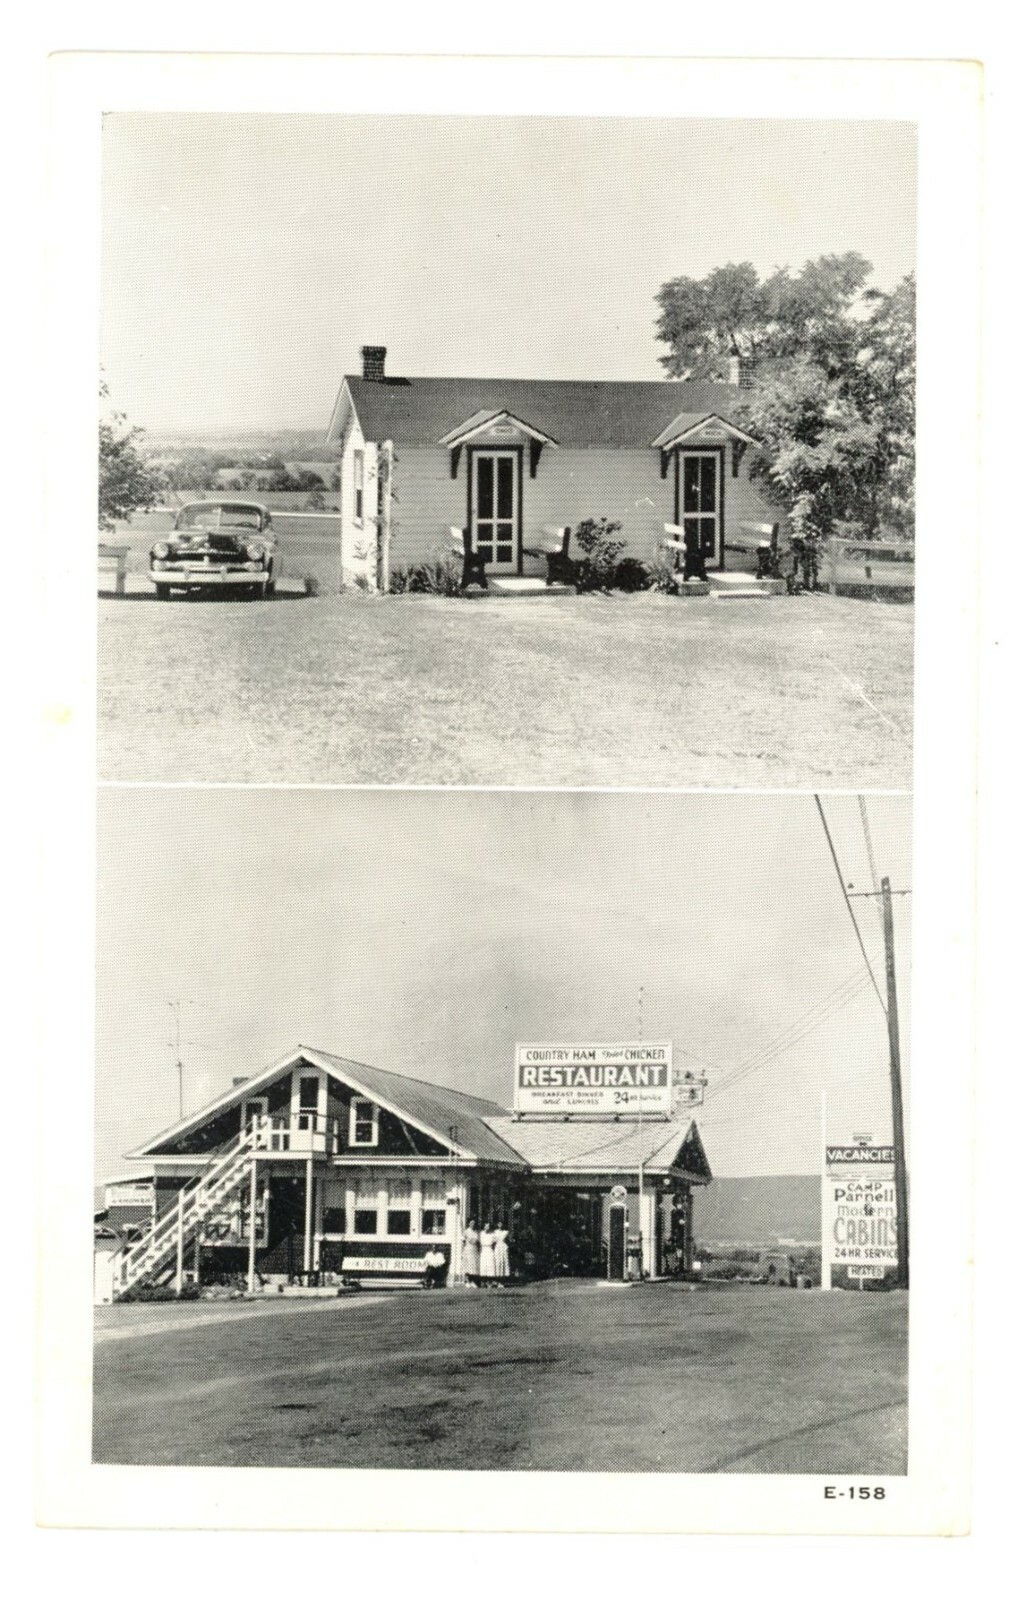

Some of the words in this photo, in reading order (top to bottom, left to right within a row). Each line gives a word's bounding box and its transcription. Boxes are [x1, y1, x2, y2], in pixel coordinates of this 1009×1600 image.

[527, 1050, 569, 1061] COUNTRY
[573, 1050, 596, 1060] HAM
[625, 1049, 665, 1060] CHICKEN
[522, 1066, 663, 1086] RESTAURANT
[614, 1091, 629, 1104] 24
[847, 1182, 883, 1192] CAMP
[834, 1187, 894, 1202] Parnell
[834, 1247, 847, 1258] 24
